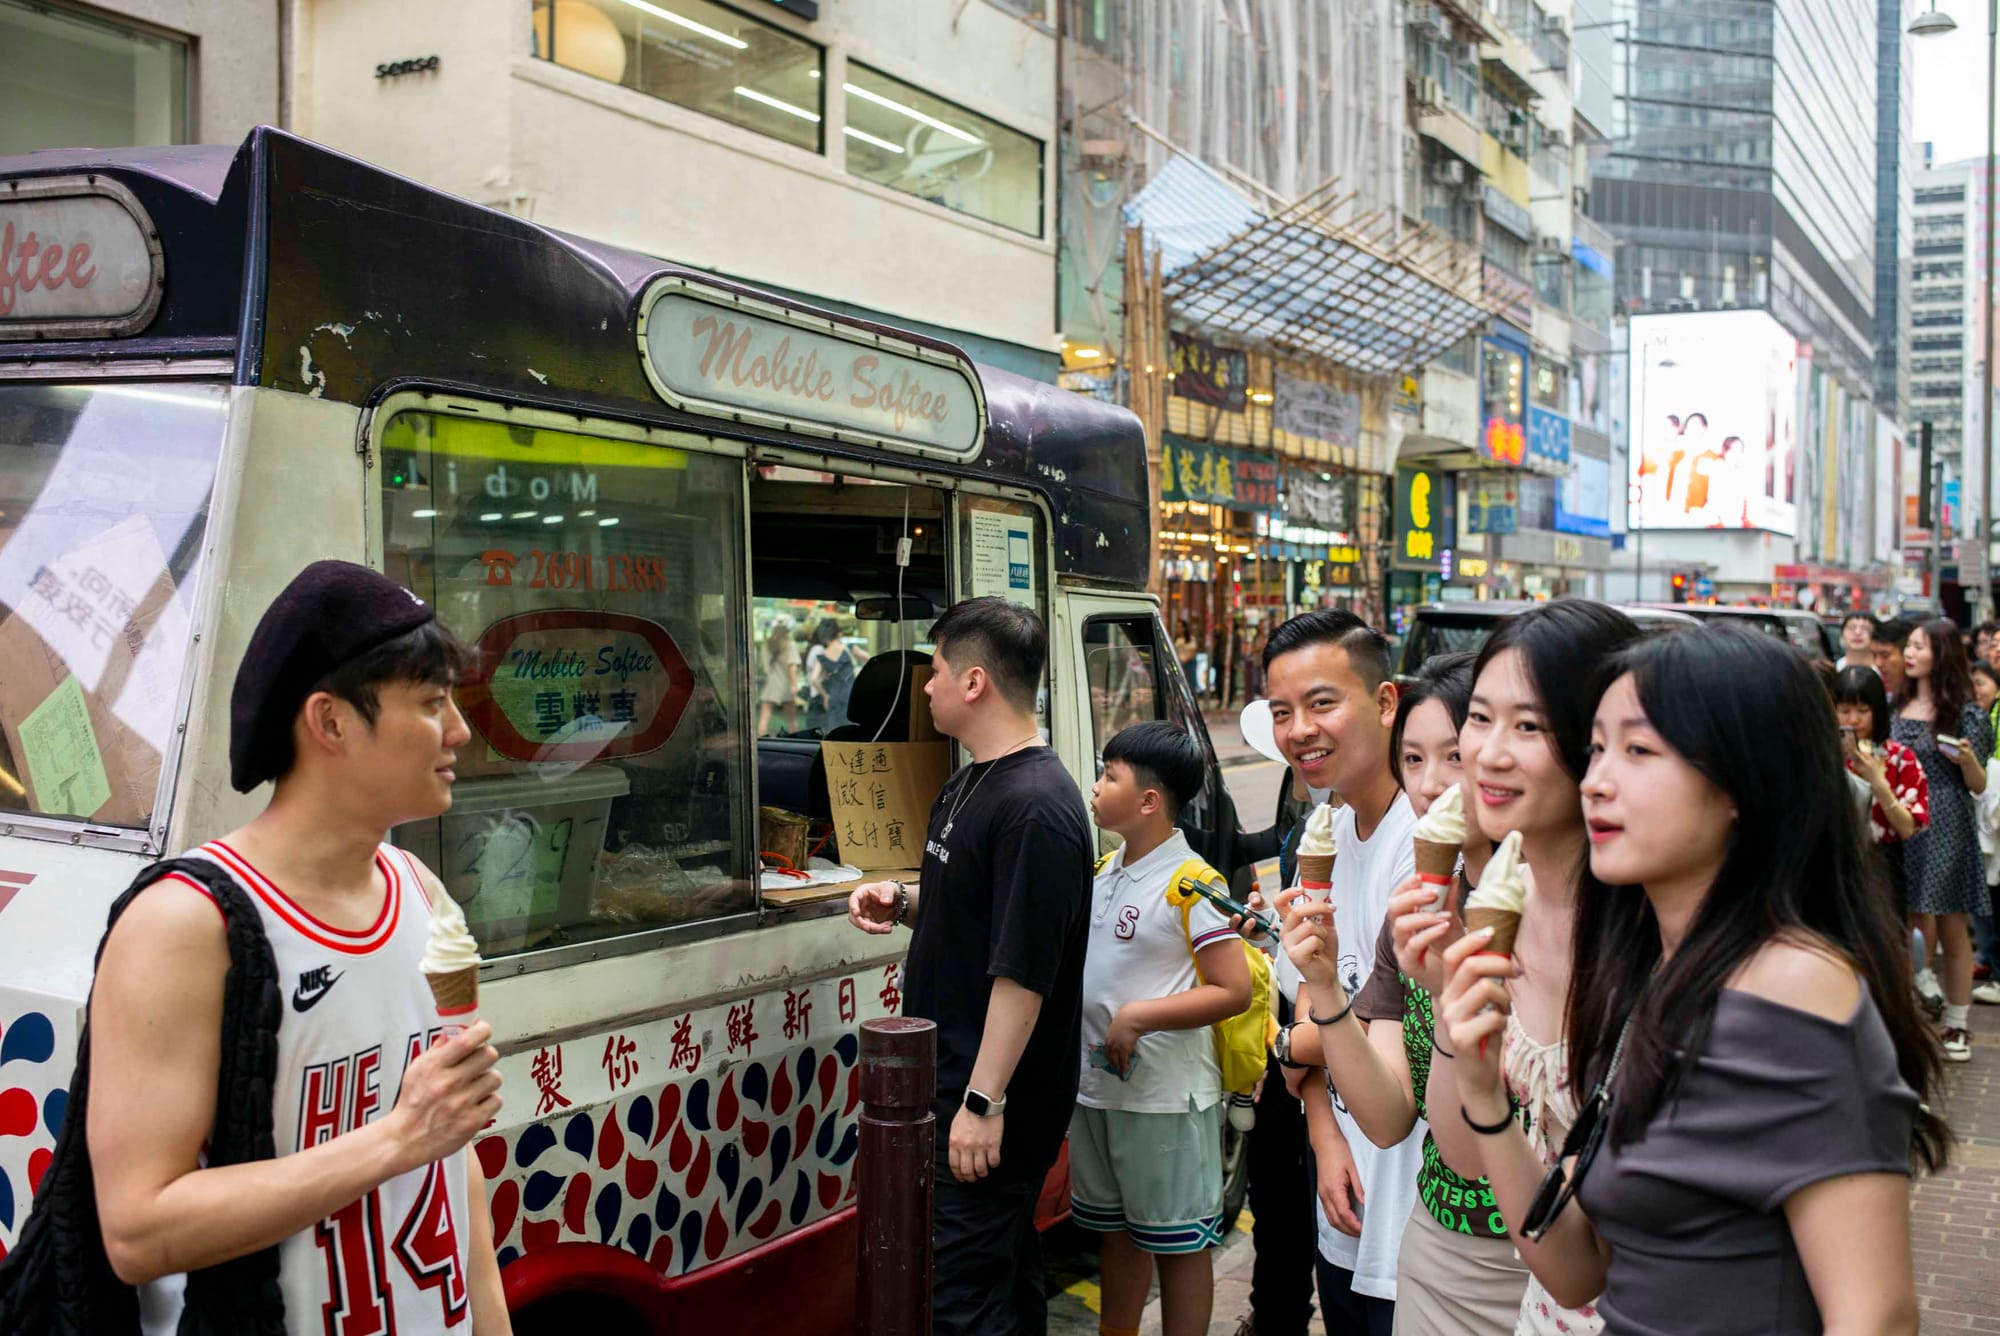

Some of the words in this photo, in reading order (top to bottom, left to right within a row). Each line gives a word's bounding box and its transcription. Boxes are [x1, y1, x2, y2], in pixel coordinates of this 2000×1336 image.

[375, 56, 440, 78] sense
[0, 221, 96, 316] ftee
[692, 314, 834, 403] Mobile
[849, 355, 949, 431] Softee
[529, 550, 593, 591] 2691
[607, 555, 667, 593] 1388
[511, 649, 586, 680] Mobile
[595, 646, 653, 682] Softee
[535, 690, 638, 735] 雪糕車
[830, 748, 893, 775] 八達通
[835, 777, 887, 811] 微信
[845, 819, 905, 851] 支付寶
[1115, 905, 1140, 940] S
[299, 965, 332, 995] NIKE
[314, 1158, 469, 1336] 14
